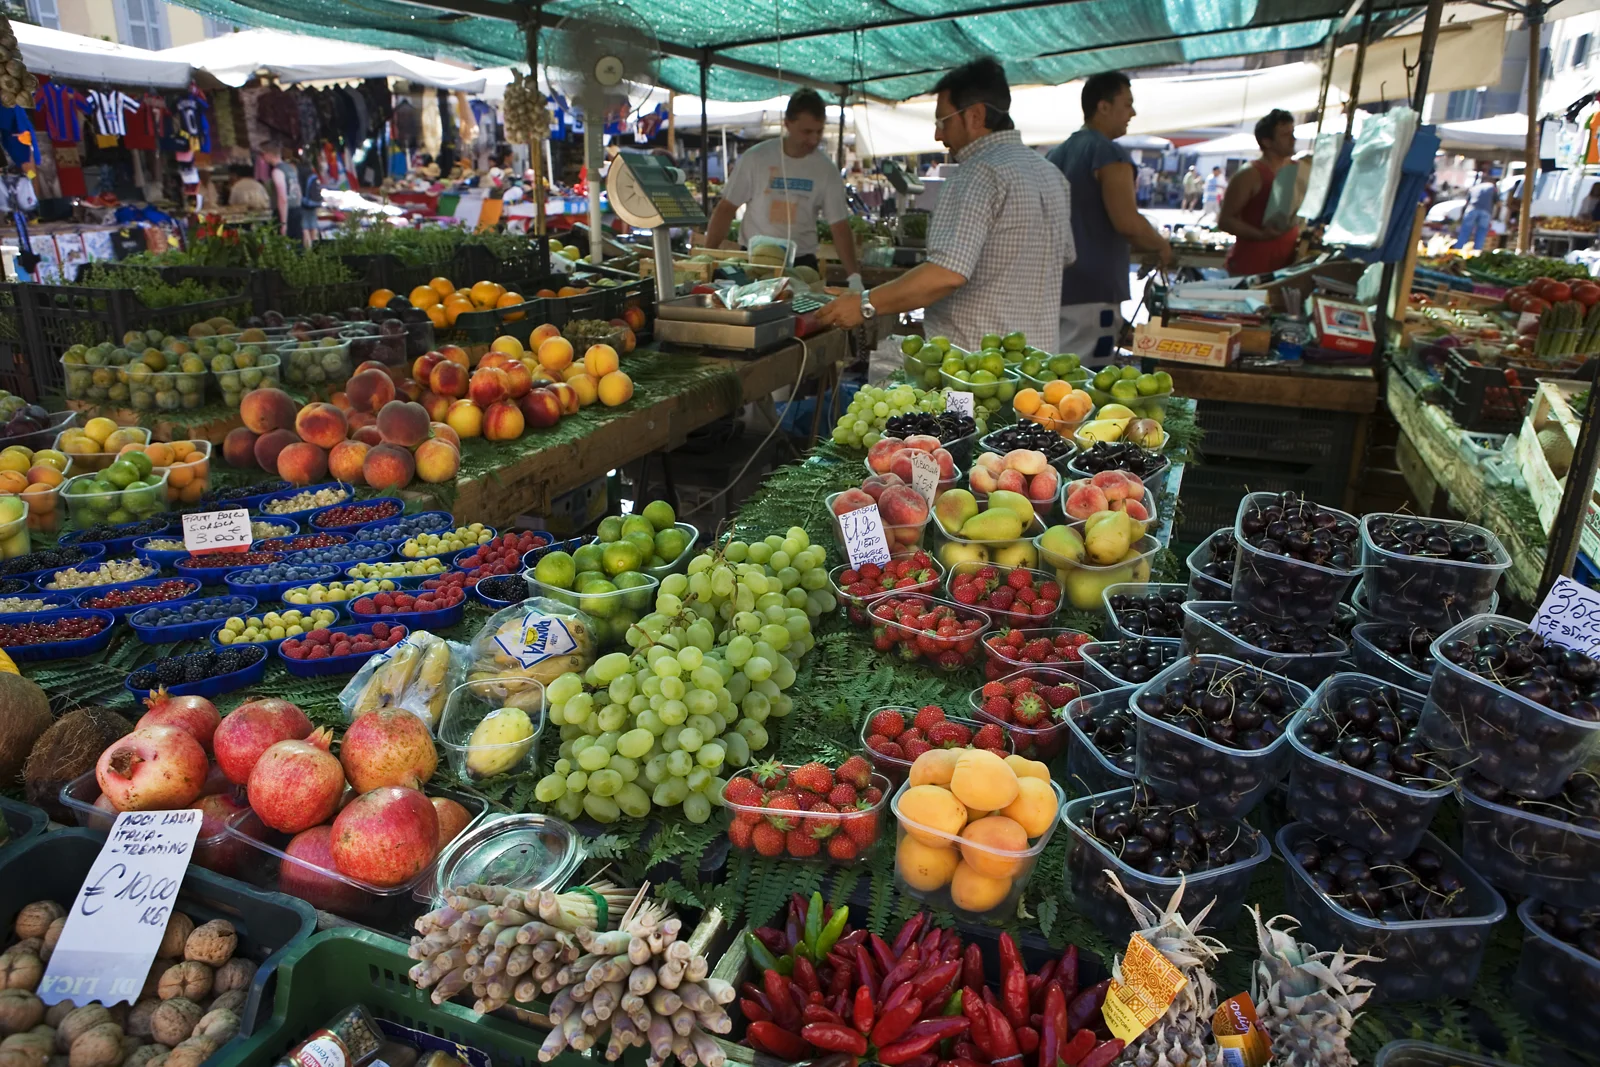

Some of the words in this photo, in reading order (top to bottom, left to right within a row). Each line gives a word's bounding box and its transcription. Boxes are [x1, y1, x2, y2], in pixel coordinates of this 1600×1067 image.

[1157, 339, 1214, 357] SAT'S
[1230, 1001, 1250, 1033] Delig
[310, 1043, 330, 1064] Verde
